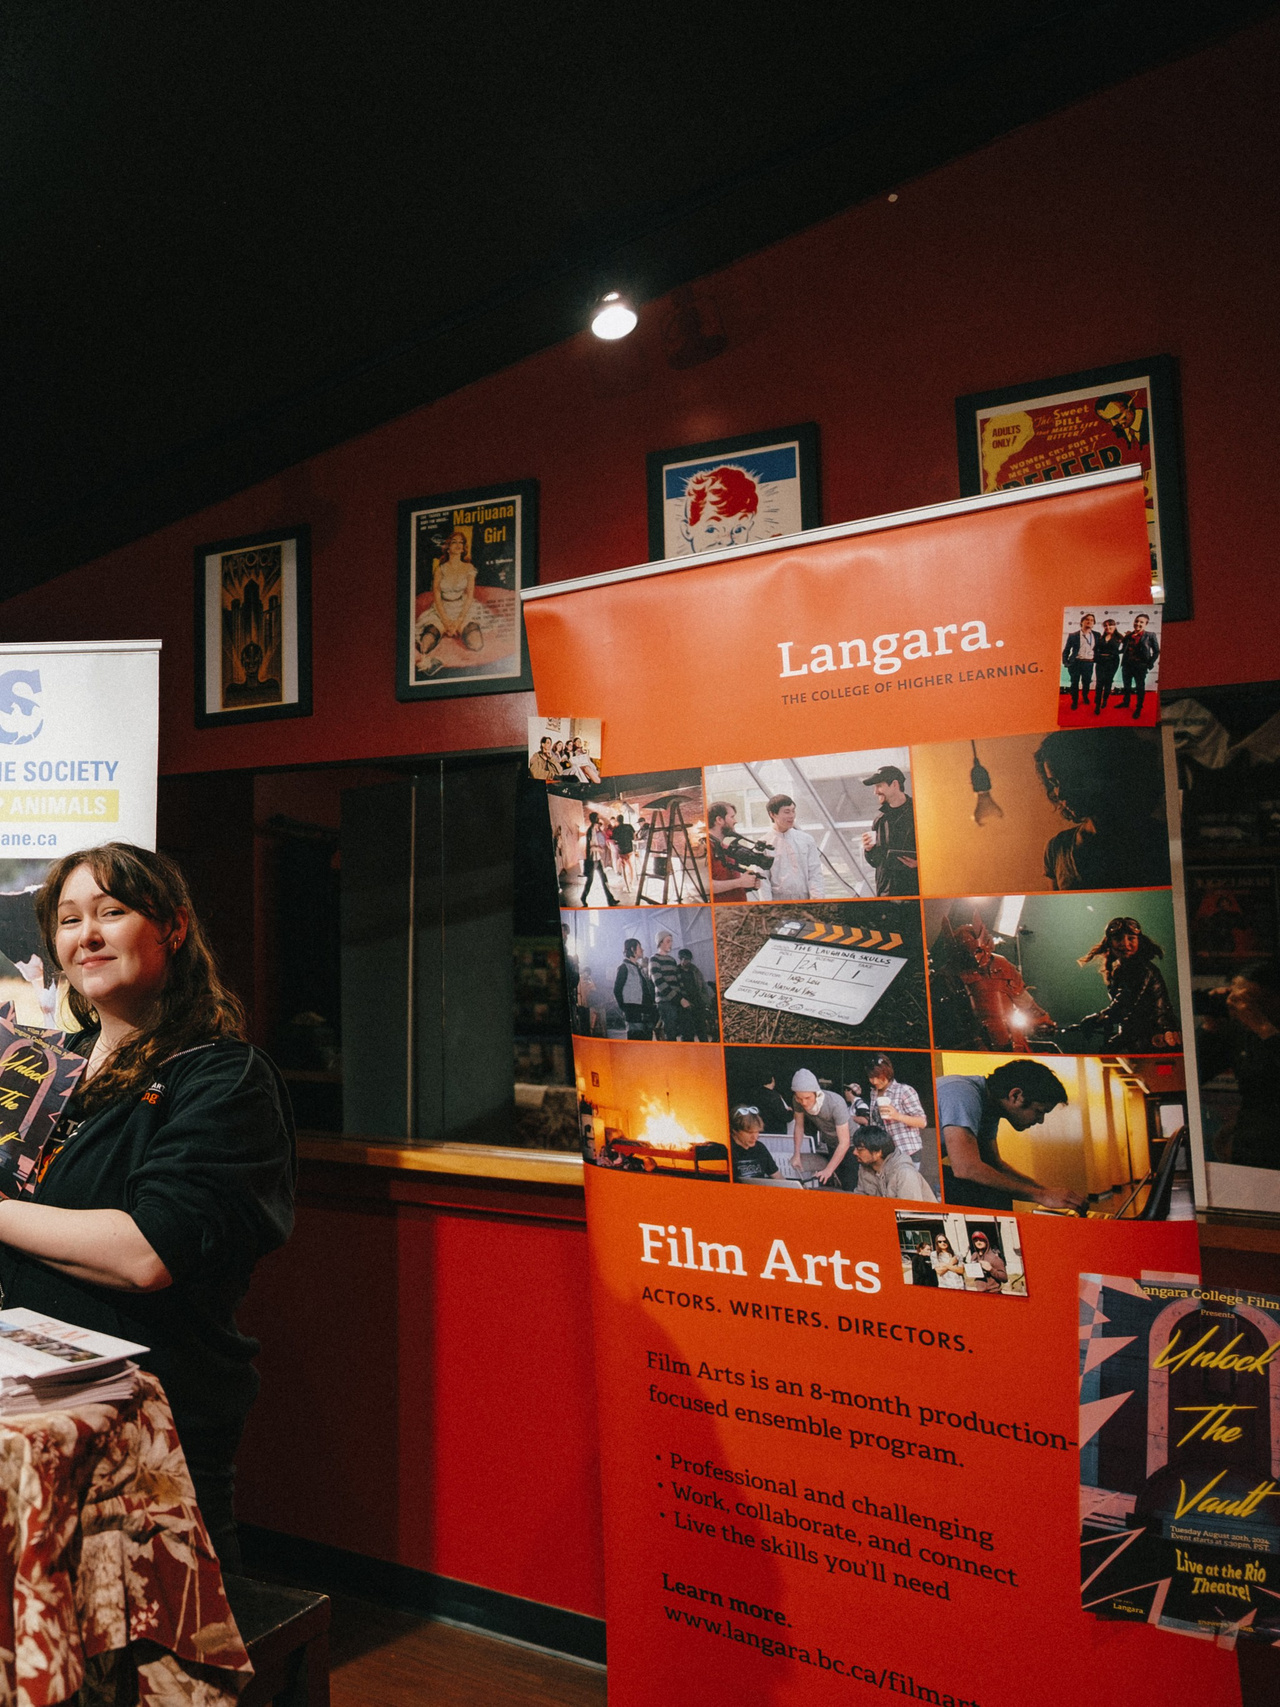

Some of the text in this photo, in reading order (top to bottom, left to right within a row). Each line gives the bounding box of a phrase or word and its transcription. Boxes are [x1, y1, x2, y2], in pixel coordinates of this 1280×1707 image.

[1053, 405, 1090, 420] Sweet
[1055, 417, 1082, 427] PILL
[992, 425, 1021, 437] ADULTS
[992, 436, 1017, 449] ONLY!
[1051, 424, 1080, 434] MAKES
[1008, 468, 1030, 480] MEN
[1035, 460, 1051, 470] DIE
[1056, 452, 1075, 462] FOR
[1009, 455, 1045, 471] WOMEN
[1048, 447, 1065, 457] CRY
[1068, 440, 1087, 450] FOR
[453, 505, 514, 526] Marijuana
[484, 526, 506, 543] Girl
[777, 620, 1005, 678] Langara.
[781, 662, 1044, 705] THE COLLEGE OF HIGHER LEARNING.
[23, 760, 119, 782] SOCIETY
[9, 796, 106, 815] ANIMALS
[793, 944, 892, 964] THE LAUGHING SKULLS
[798, 959, 818, 971] 2A
[638, 1222, 882, 1294] Film Arts
[1134, 1284, 1280, 1310] Langara College Film
[642, 1286, 974, 1354] ACTORS. WRITERS. DIRECTORS.
[1200, 1308, 1235, 1319] Presents
[1153, 1325, 1280, 1375] Unlock
[647, 1351, 1078, 1451] Film Arts is an 8-month production-
[648, 1384, 965, 1468] focused ensemble program.
[1174, 1403, 1259, 1448] The
[670, 1452, 995, 1552] Professional and challenging
[1174, 1469, 1280, 1520] Vault
[672, 1481, 1019, 1588] Work, collaborate, and connect
[1170, 1525, 1201, 1537] Tuesday
[1203, 1530, 1229, 1541] August
[1170, 1532, 1192, 1541] Event
[1193, 1537, 1214, 1545] starts
[674, 1511, 951, 1601] Live the skills you'll need
[1175, 1548, 1267, 1583] Live at the Rio
[662, 1572, 793, 1628] Learn more.
[1191, 1577, 1251, 1603] Theatre!
